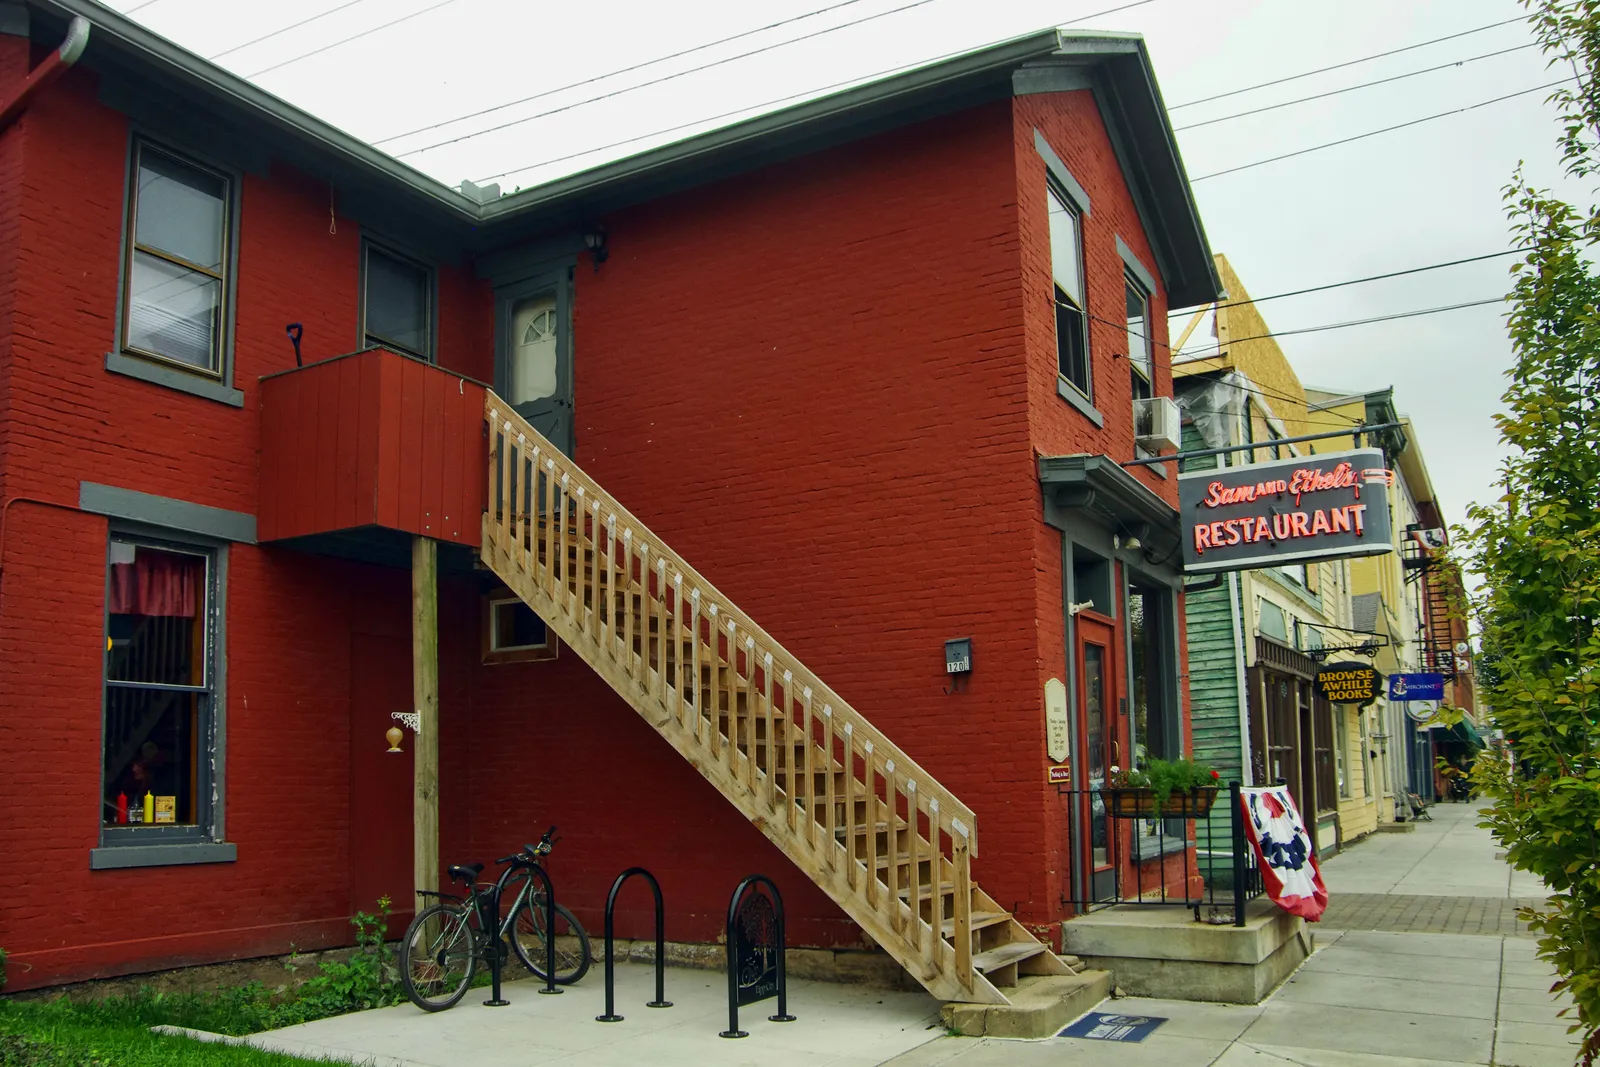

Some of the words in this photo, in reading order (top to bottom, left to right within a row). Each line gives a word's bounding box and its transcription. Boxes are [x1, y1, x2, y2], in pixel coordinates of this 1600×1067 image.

[1204, 481, 1257, 508] Sam
[1256, 479, 1287, 497] AND
[1288, 462, 1363, 495] Ethel's
[1195, 504, 1367, 549] RESTAURANT
[948, 662, 964, 672] 120
[1319, 669, 1375, 682] BROWSE
[1322, 679, 1373, 691] AWHILE
[1328, 688, 1373, 700] BOOKS
